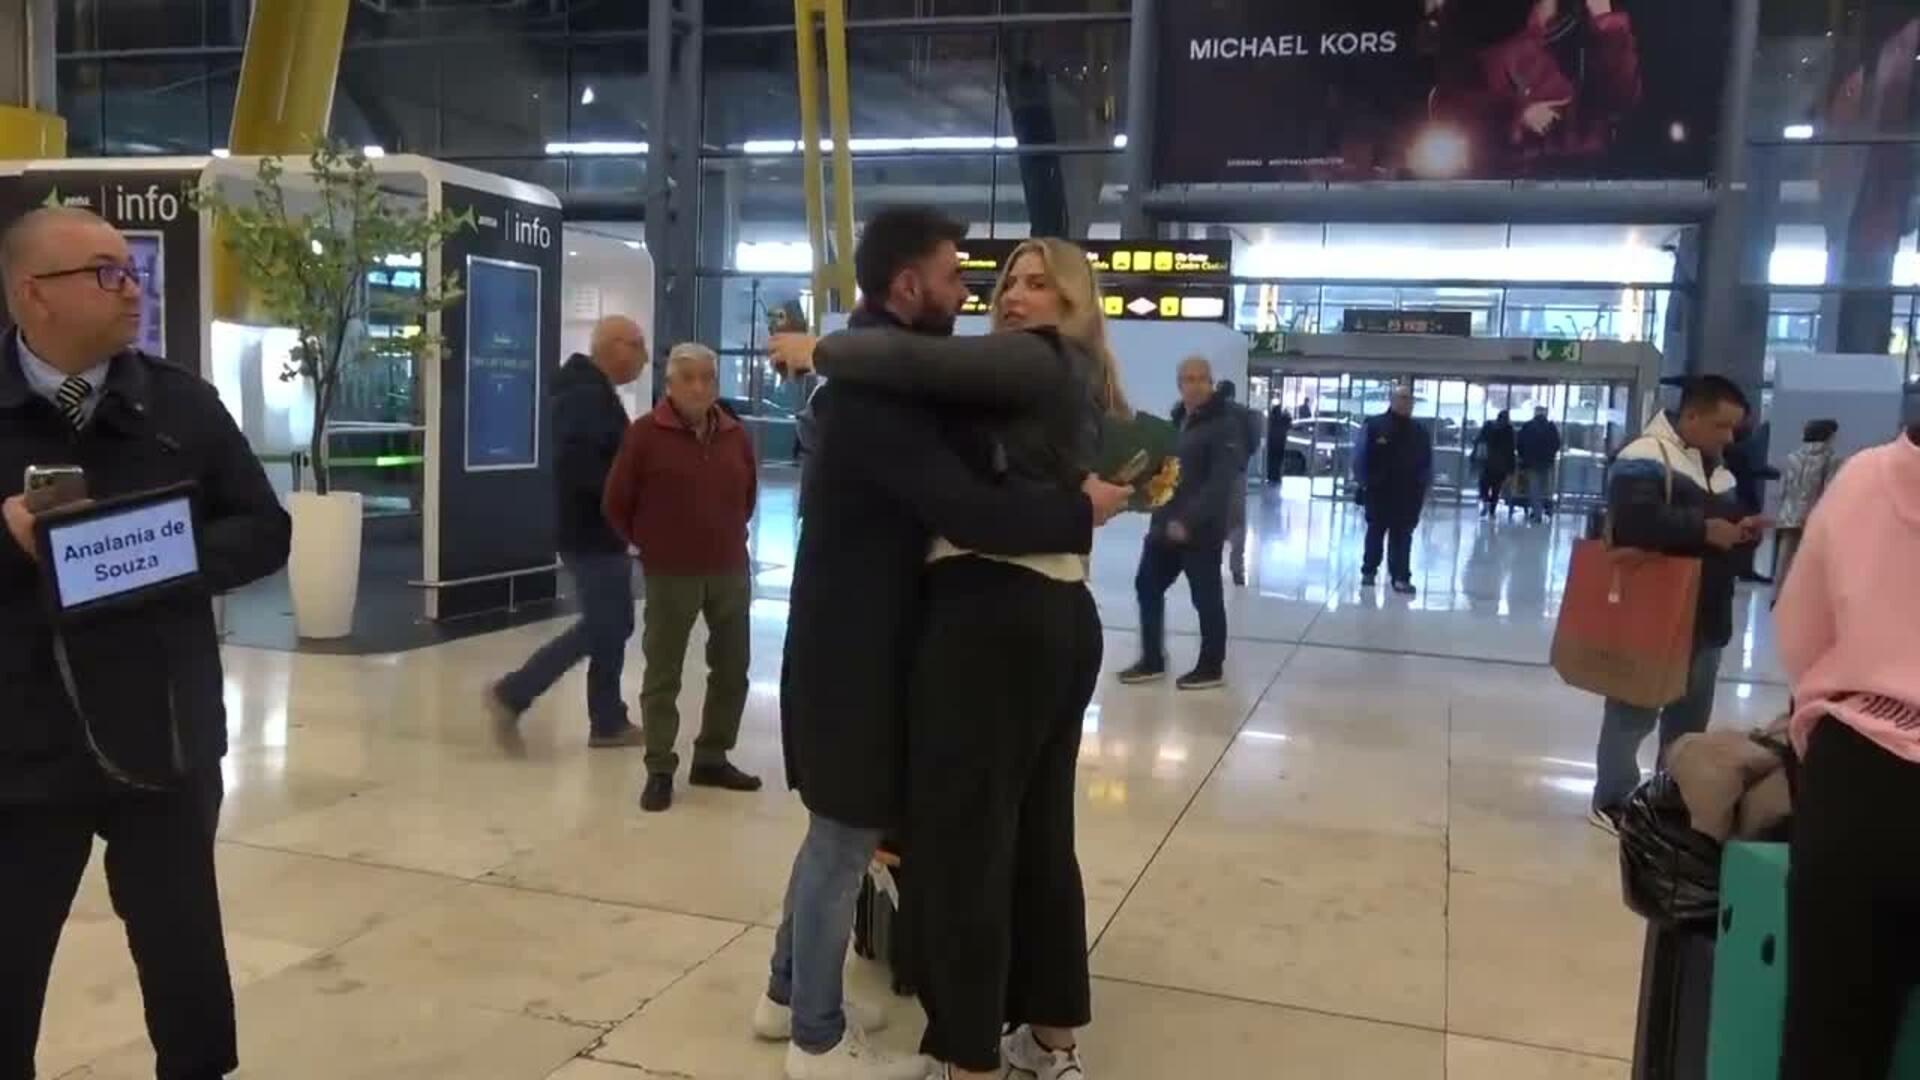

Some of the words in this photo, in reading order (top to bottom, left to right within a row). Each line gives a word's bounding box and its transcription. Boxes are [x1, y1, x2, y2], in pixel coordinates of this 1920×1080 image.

[1190, 35, 1309, 60] MICHAEL
[1320, 30, 1398, 56] KORS
[116, 184, 178, 222] info
[515, 212, 551, 249] info
[64, 527, 155, 562] Analania
[160, 519, 186, 538] de
[94, 553, 160, 582] Souza
